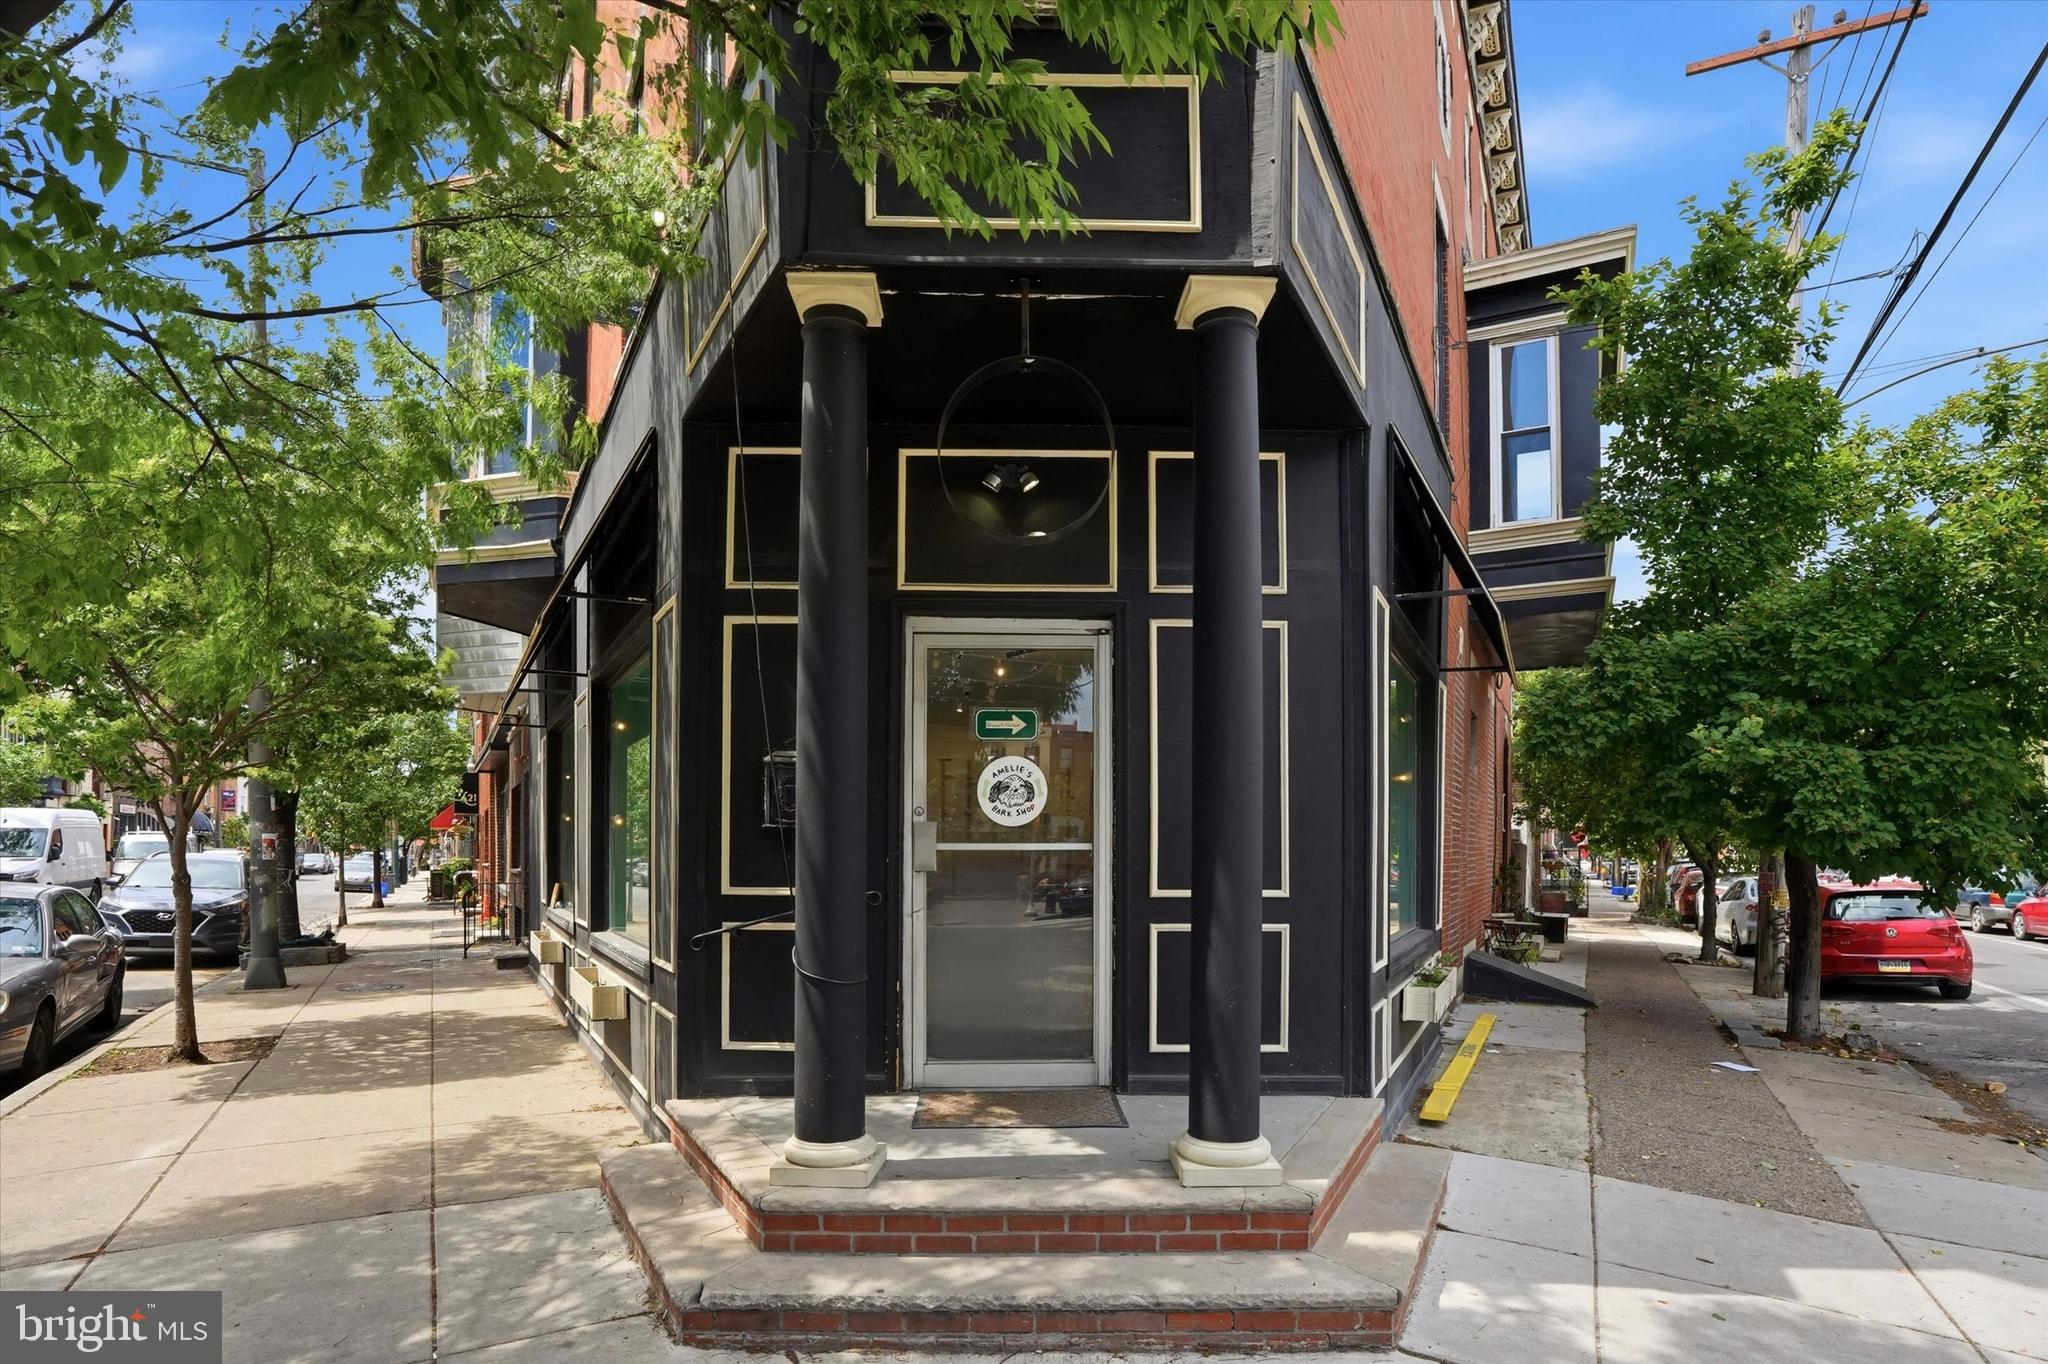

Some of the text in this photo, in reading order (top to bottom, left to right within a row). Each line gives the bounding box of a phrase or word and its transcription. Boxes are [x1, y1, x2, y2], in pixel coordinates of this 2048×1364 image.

[992, 765, 1033, 779] AMELIE'S
[991, 804, 1035, 817] BARK SHOP
